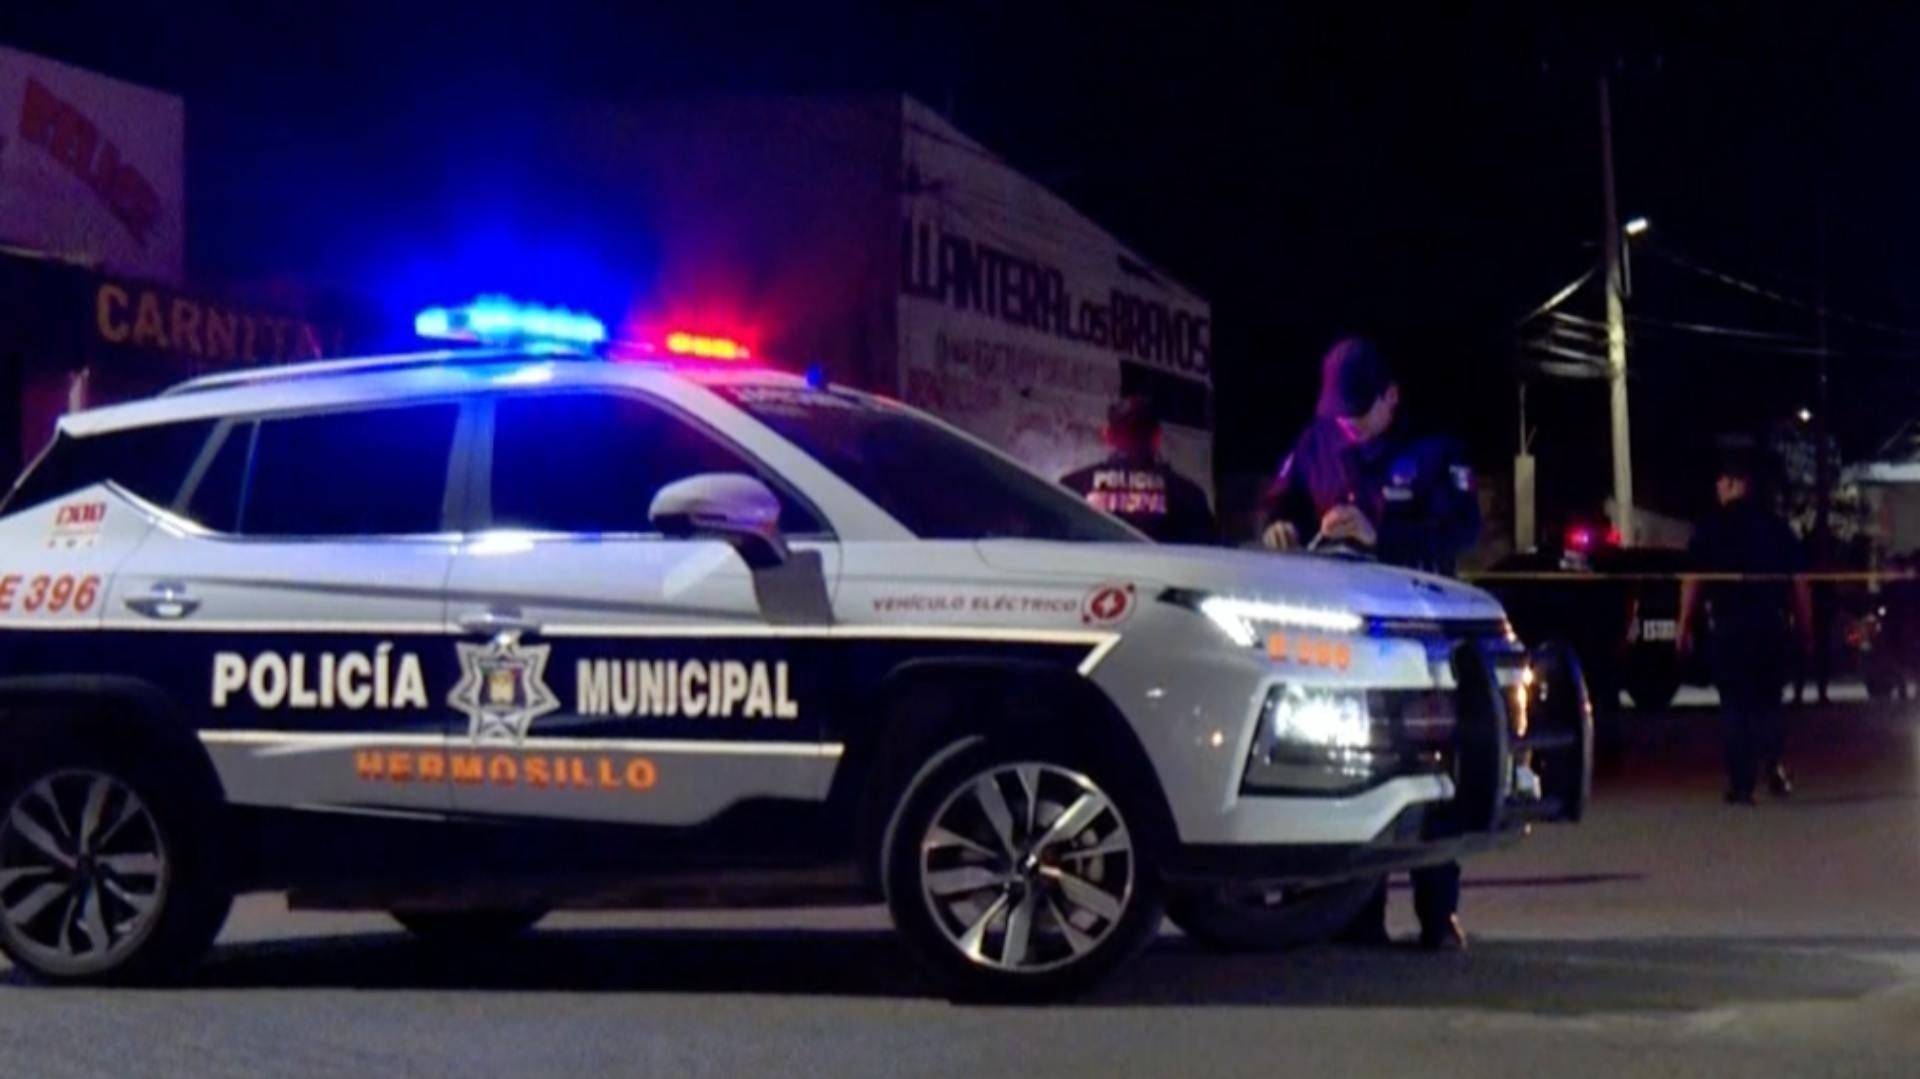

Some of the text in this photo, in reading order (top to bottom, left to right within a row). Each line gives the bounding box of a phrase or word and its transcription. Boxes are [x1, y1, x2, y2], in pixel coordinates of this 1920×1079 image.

[1110, 288, 1211, 374] BRAVOS
[24, 574, 101, 612] 396
[211, 641, 798, 719] POLICÍA MUNICIPAL
[355, 750, 657, 789] HERMOSILLO
